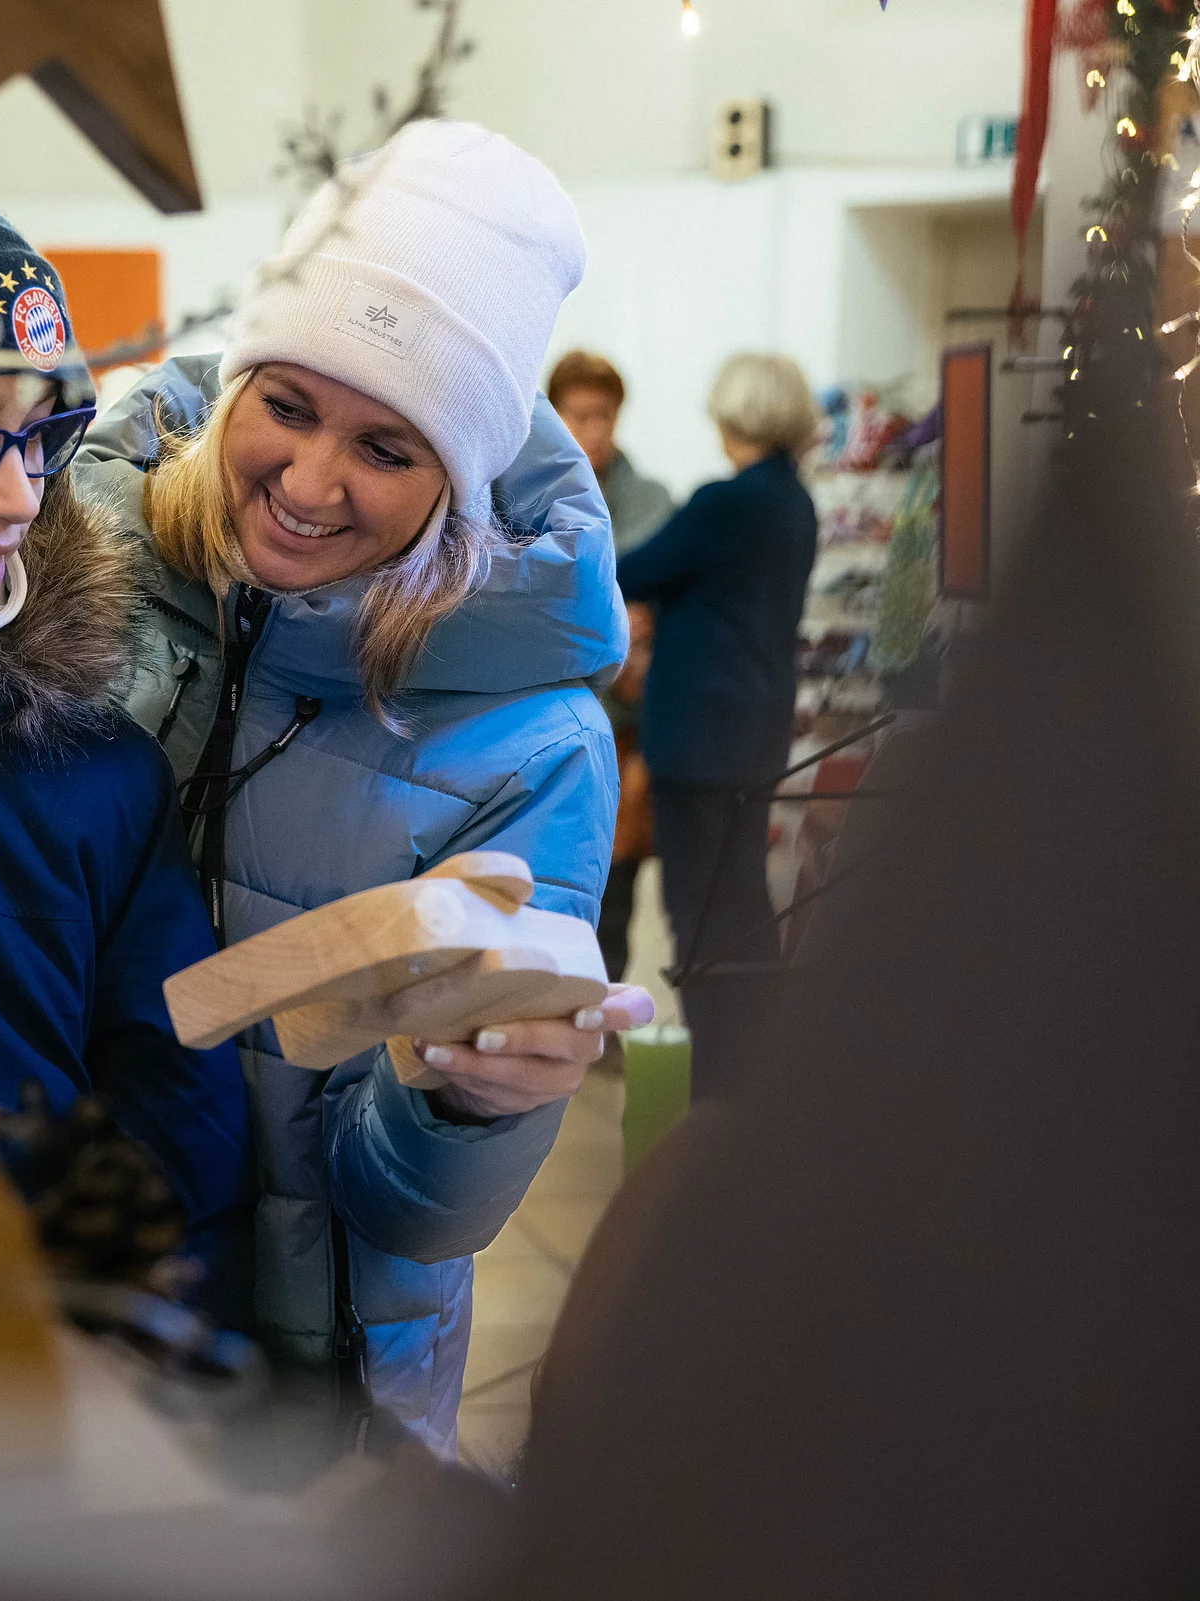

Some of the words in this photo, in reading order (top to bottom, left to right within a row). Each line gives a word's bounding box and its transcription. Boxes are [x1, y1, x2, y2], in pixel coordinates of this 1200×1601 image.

[15, 304, 27, 324] FC
[24, 291, 61, 323] BAYERN
[347, 318, 366, 330] ALPHA
[367, 327, 403, 347] INDUSTRIES
